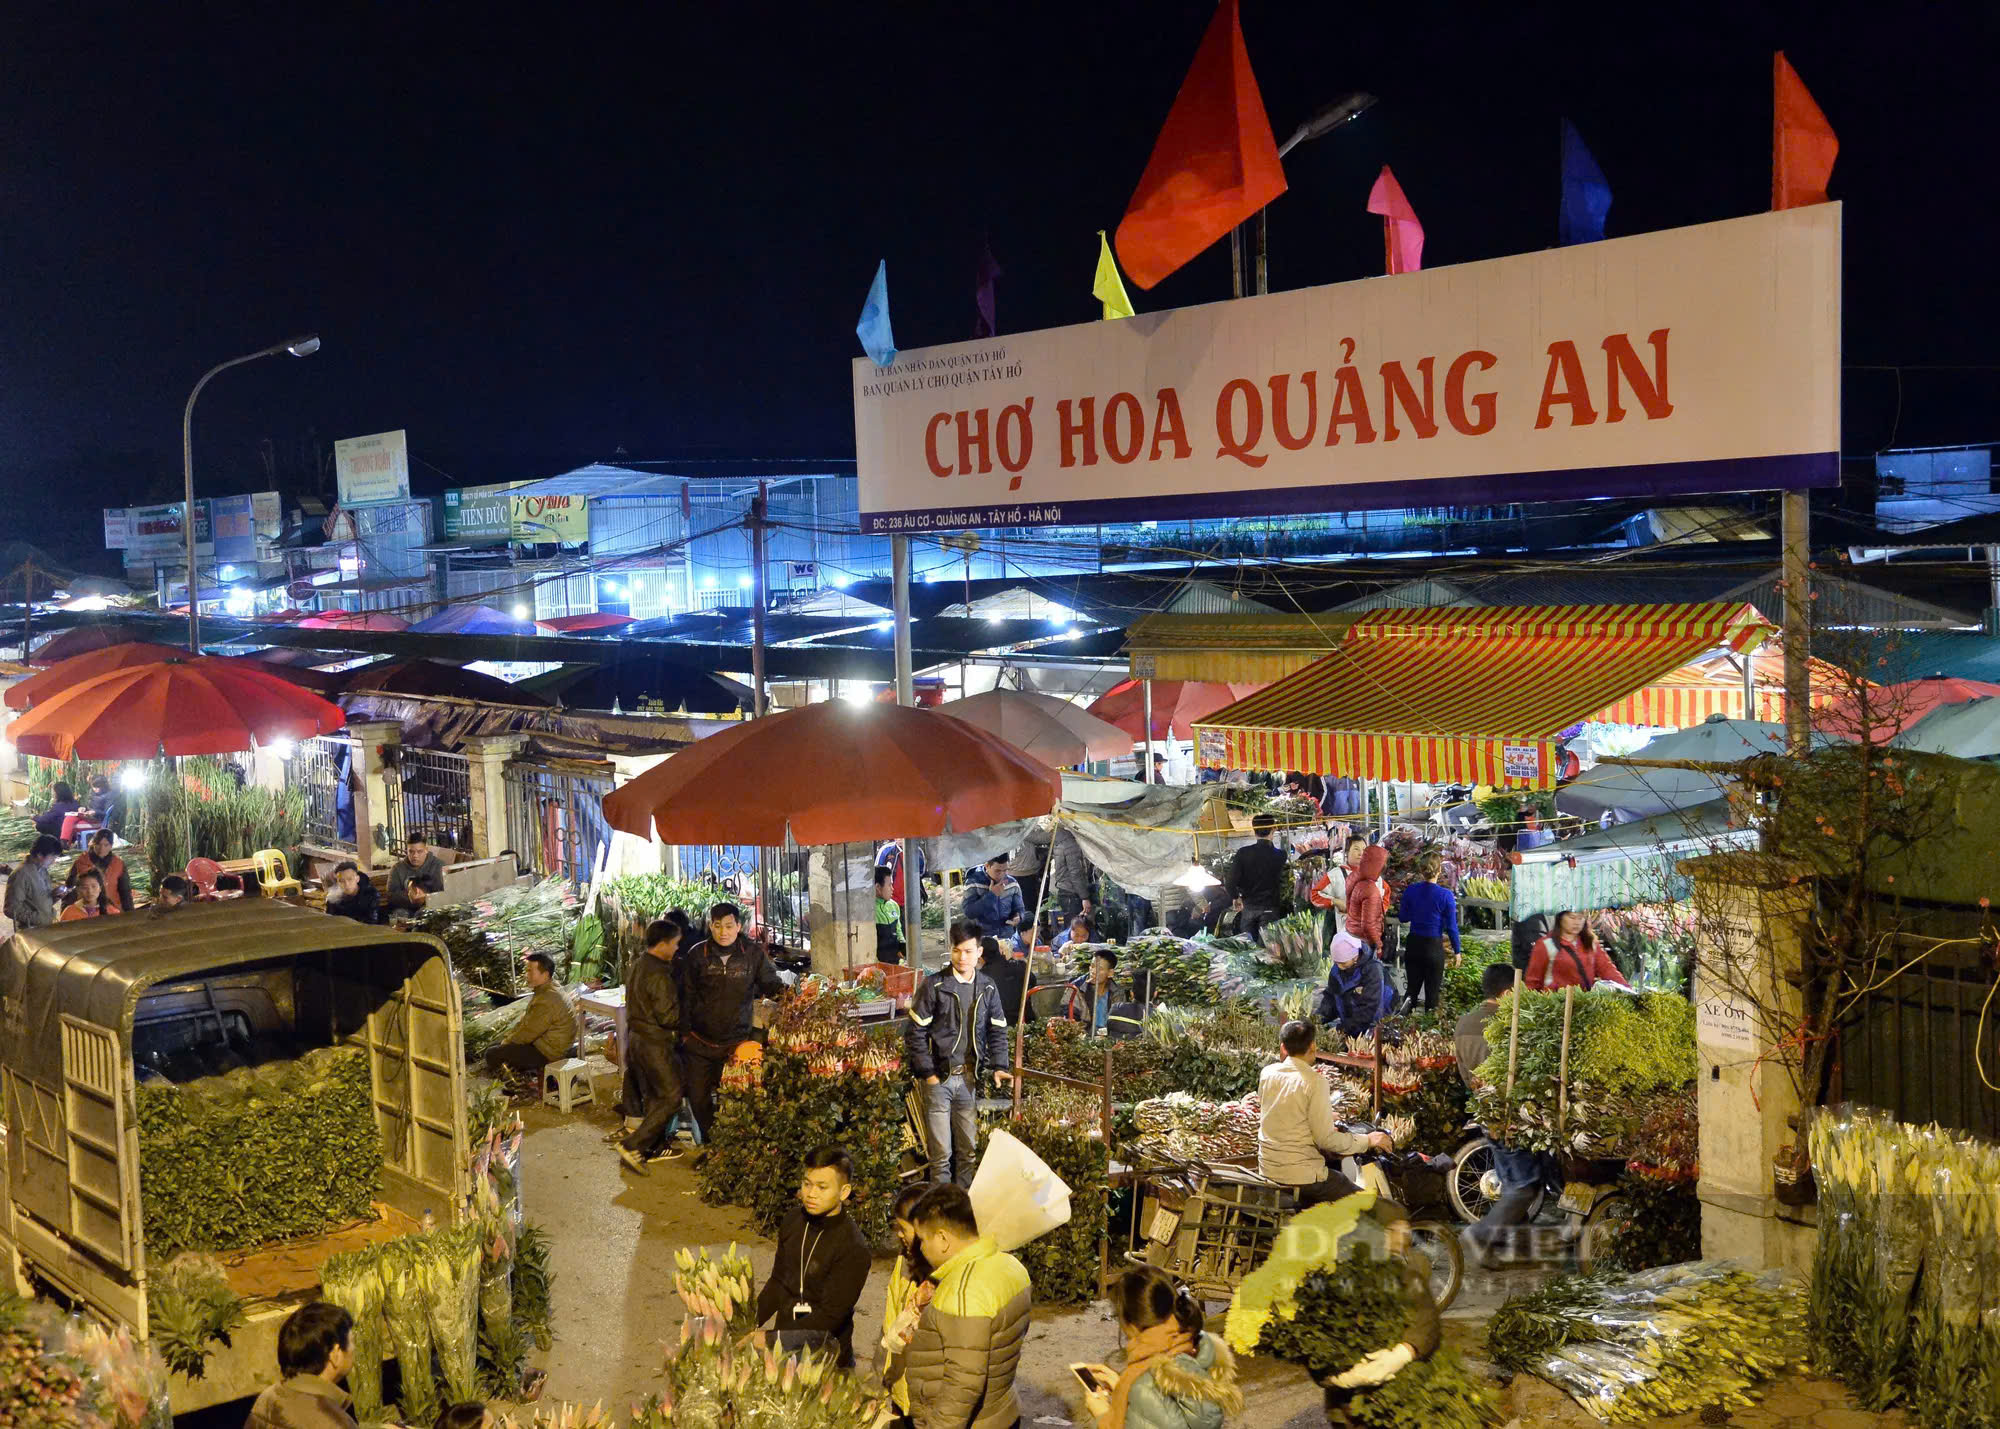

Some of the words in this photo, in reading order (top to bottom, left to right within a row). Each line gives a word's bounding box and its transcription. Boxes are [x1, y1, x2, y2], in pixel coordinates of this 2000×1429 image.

[863, 384, 882, 397] BAN
[951, 369, 980, 386] QUẬN
[982, 365, 1006, 381] TÂY
[1006, 360, 1023, 379] HỒ
[926, 397, 1034, 490] CHỢ
[1056, 387, 1193, 467] HOA
[1215, 337, 1499, 468] QUẢNG
[1534, 328, 1674, 430] AN
[461, 501, 483, 526] TIẾN
[486, 501, 508, 525] ĐỨC
[873, 518, 887, 529] ĐC:
[889, 517, 902, 528] 236
[936, 510, 967, 526] QUẢNG
[968, 513, 981, 525] AN
[988, 510, 1007, 524] TÂY
[1008, 506, 1022, 523] HỒ
[1029, 507, 1043, 521] HÀ
[1045, 506, 1061, 523] NỘI
[794, 563, 814, 574] WC
[1704, 1003, 1721, 1017] XE
